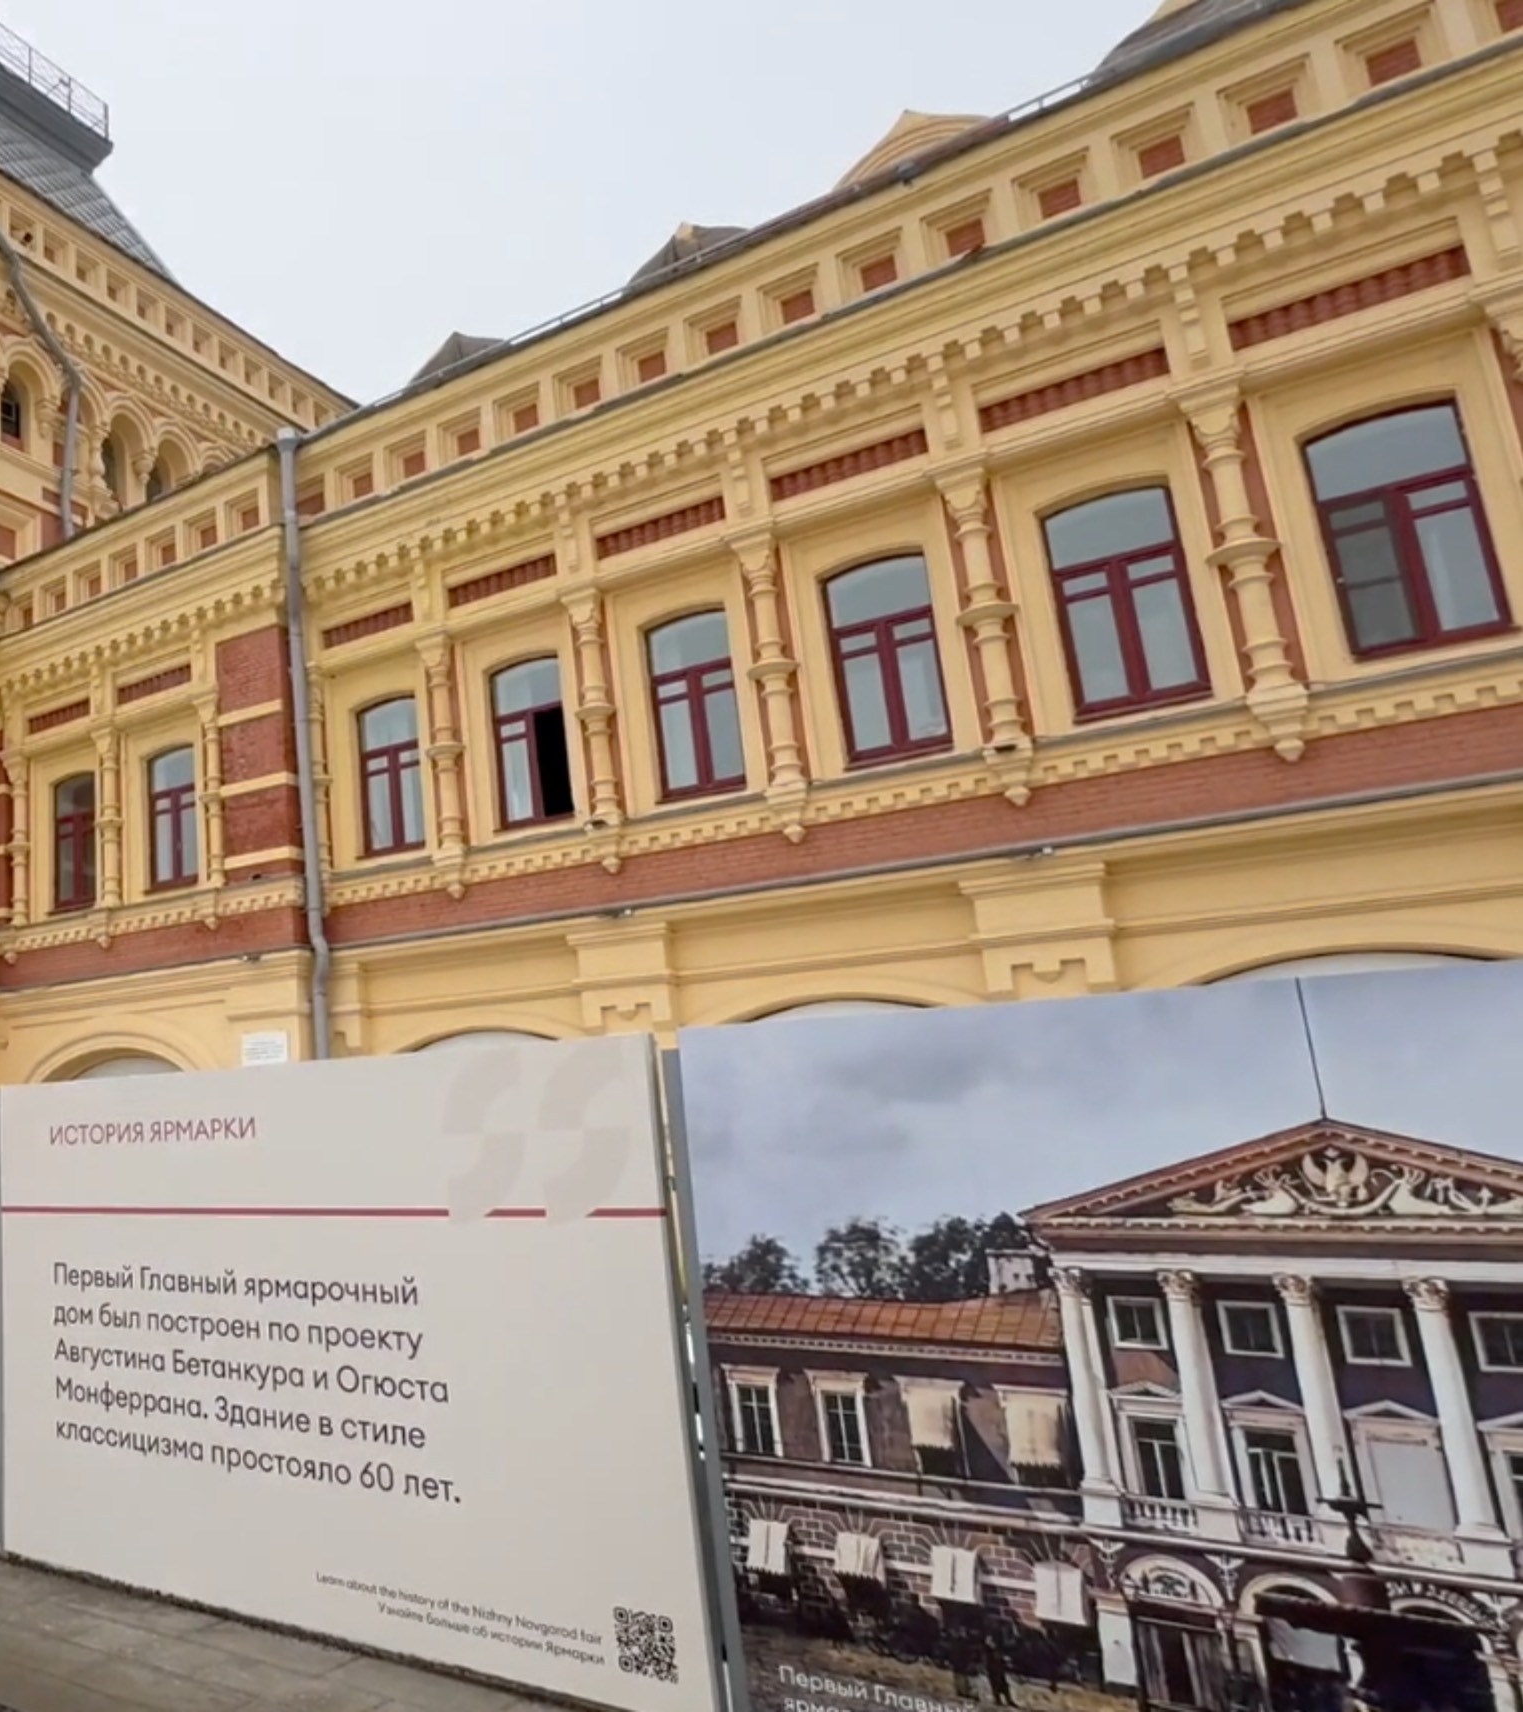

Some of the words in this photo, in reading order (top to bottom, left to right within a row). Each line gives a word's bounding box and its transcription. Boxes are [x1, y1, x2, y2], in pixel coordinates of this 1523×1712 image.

[50, 1122, 144, 1146] ИСТОРИЯ
[150, 1117, 256, 1143] ЯРМАРКИ
[54, 1262, 133, 1291] Первый
[140, 1266, 237, 1296] Главный
[244, 1276, 418, 1306] ярмарочный
[53, 1304, 93, 1327] дом
[99, 1302, 141, 1329] был
[147, 1312, 260, 1341] построен
[268, 1321, 299, 1342] по
[308, 1323, 423, 1360] проекту
[54, 1338, 166, 1372] Августина
[172, 1349, 304, 1391] Бетанкура
[314, 1369, 328, 1390] и
[336, 1365, 449, 1403] Огюста
[55, 1376, 209, 1419] Монферрана.
[215, 1396, 311, 1433] Здание
[319, 1416, 333, 1436] в
[341, 1415, 426, 1449] стиле
[55, 1420, 204, 1461] классицизма
[211, 1444, 351, 1485] простояло
[360, 1462, 394, 1492] 60
[403, 1473, 461, 1503] лет.
[316, 1571, 345, 1587] Learn
[346, 1579, 377, 1595] about
[379, 1585, 397, 1599] the
[398, 1588, 435, 1609] history
[437, 1598, 449, 1610] of
[451, 1601, 469, 1616] the
[472, 1605, 513, 1627] Nizhny
[516, 1615, 578, 1641] Novgorod
[580, 1628, 602, 1645] fair
[378, 1601, 423, 1623] Узнайте
[426, 1611, 470, 1634] больше
[472, 1626, 488, 1639] об
[490, 1630, 543, 1650] истории
[545, 1640, 605, 1665] Ярмарки
[778, 1665, 868, 1700] Первый
